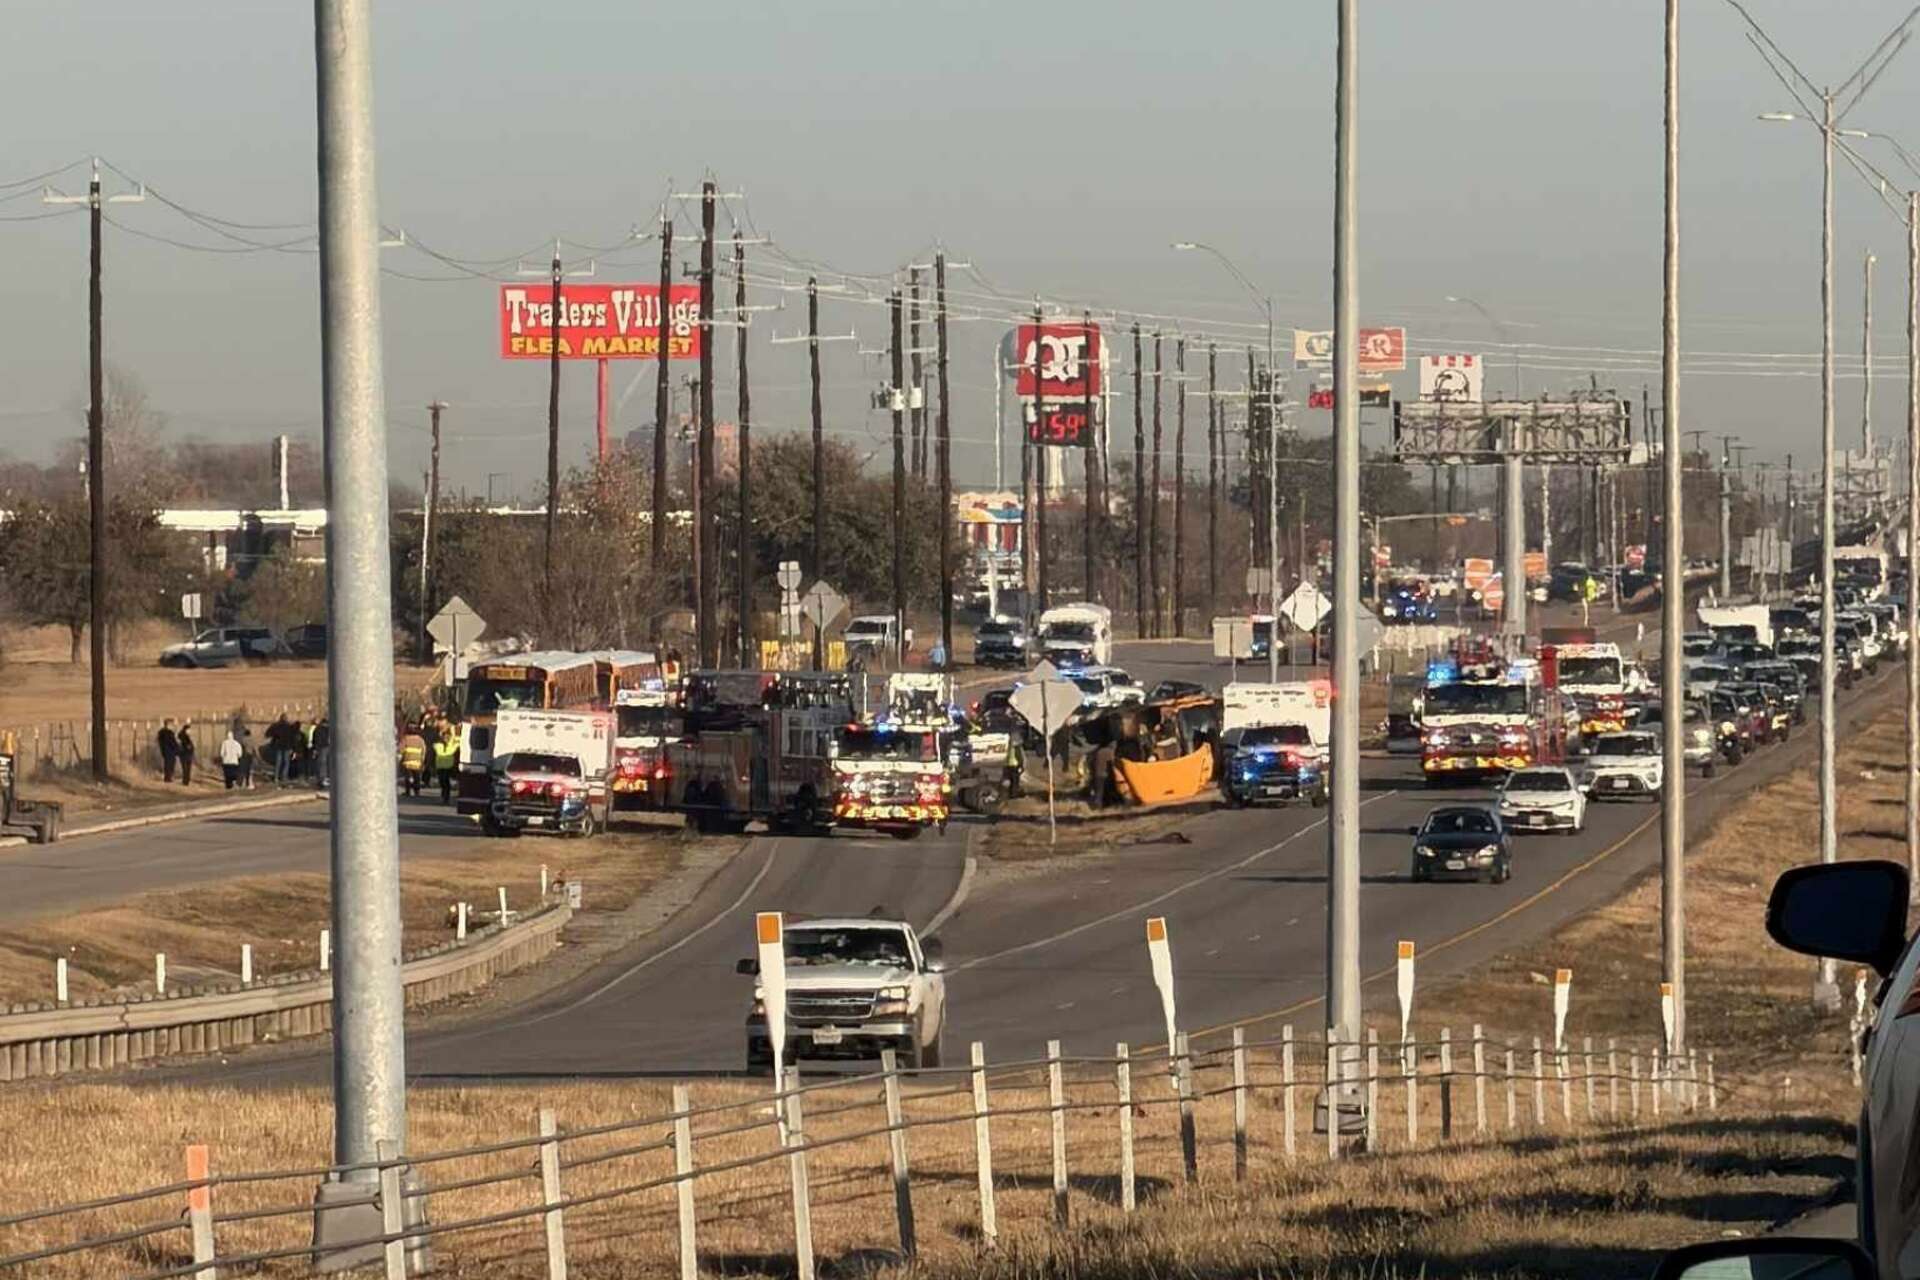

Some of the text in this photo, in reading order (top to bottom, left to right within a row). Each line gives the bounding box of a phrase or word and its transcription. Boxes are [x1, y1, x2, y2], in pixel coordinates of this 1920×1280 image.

[511, 336, 693, 354] FLEA MARKET
[1024, 335, 1086, 381] QT
